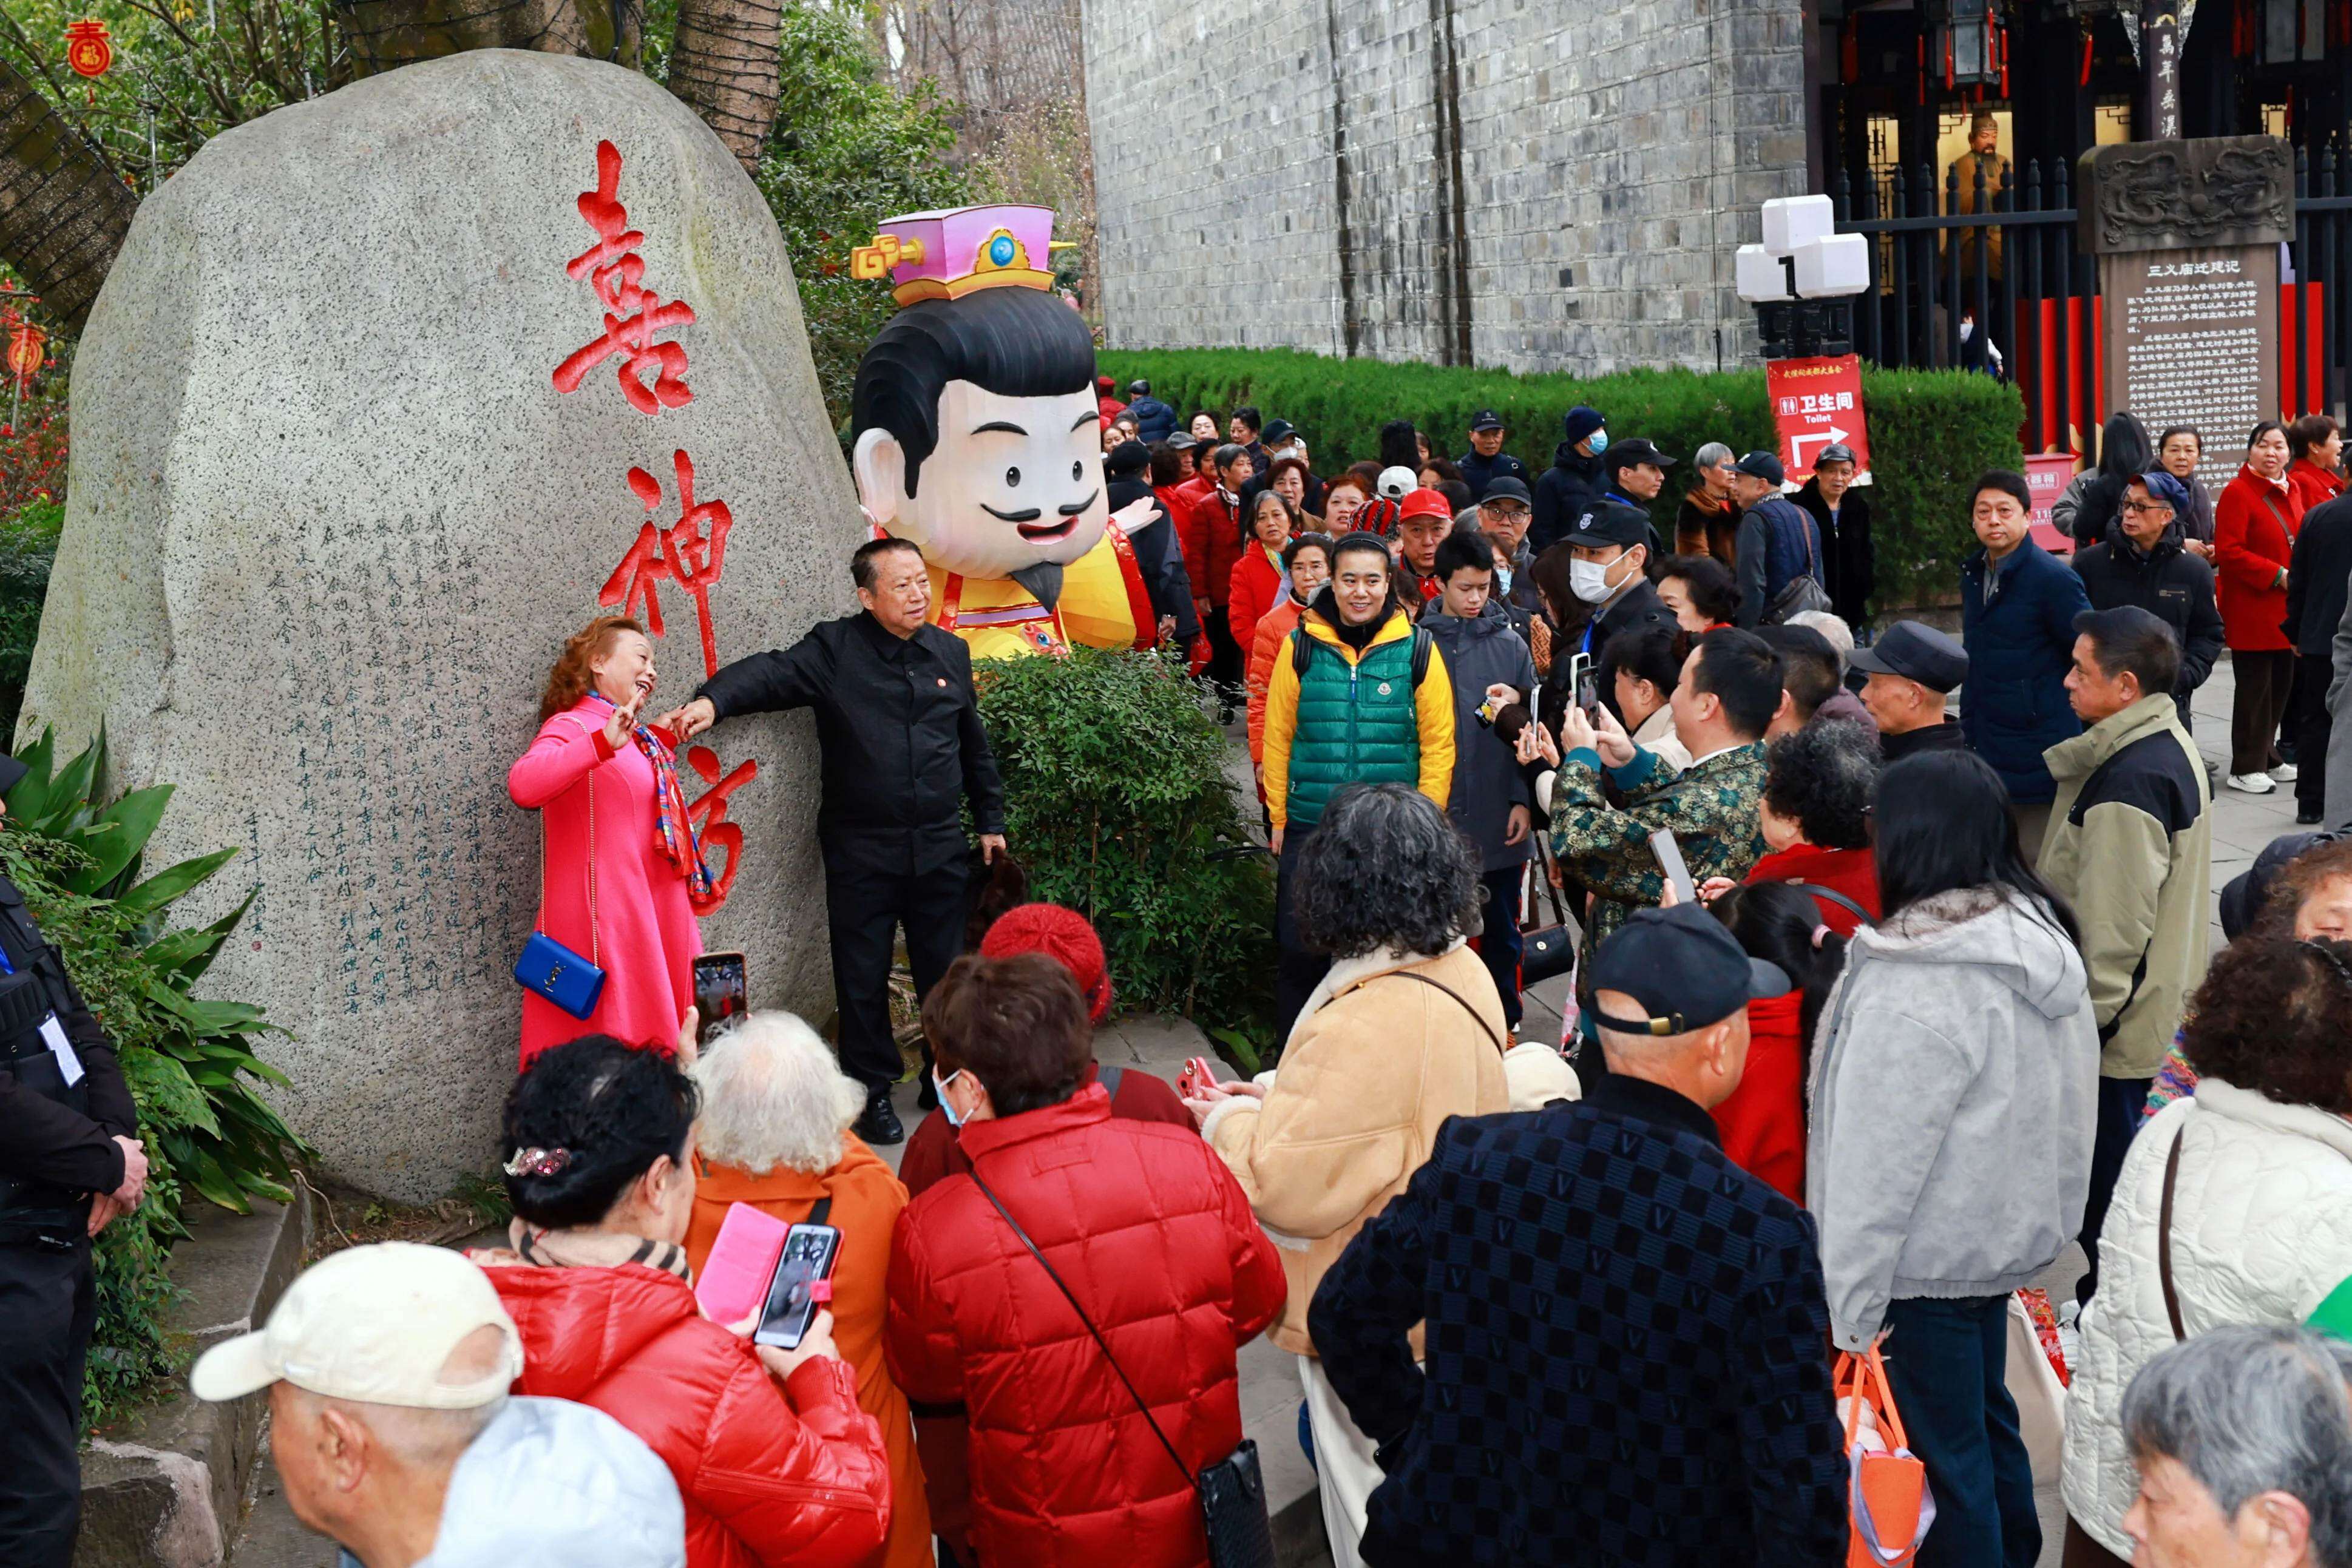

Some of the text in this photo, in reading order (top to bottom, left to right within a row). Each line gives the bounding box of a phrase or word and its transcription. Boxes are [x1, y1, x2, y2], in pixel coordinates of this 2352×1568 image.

[2147, 260, 2241, 277] 三义庙迁建记
[1800, 391, 1854, 414] 卫生间
[1805, 414, 1832, 424] Toilet
[2025, 473, 2055, 484] 器箱
[2035, 509, 2052, 519] 11
